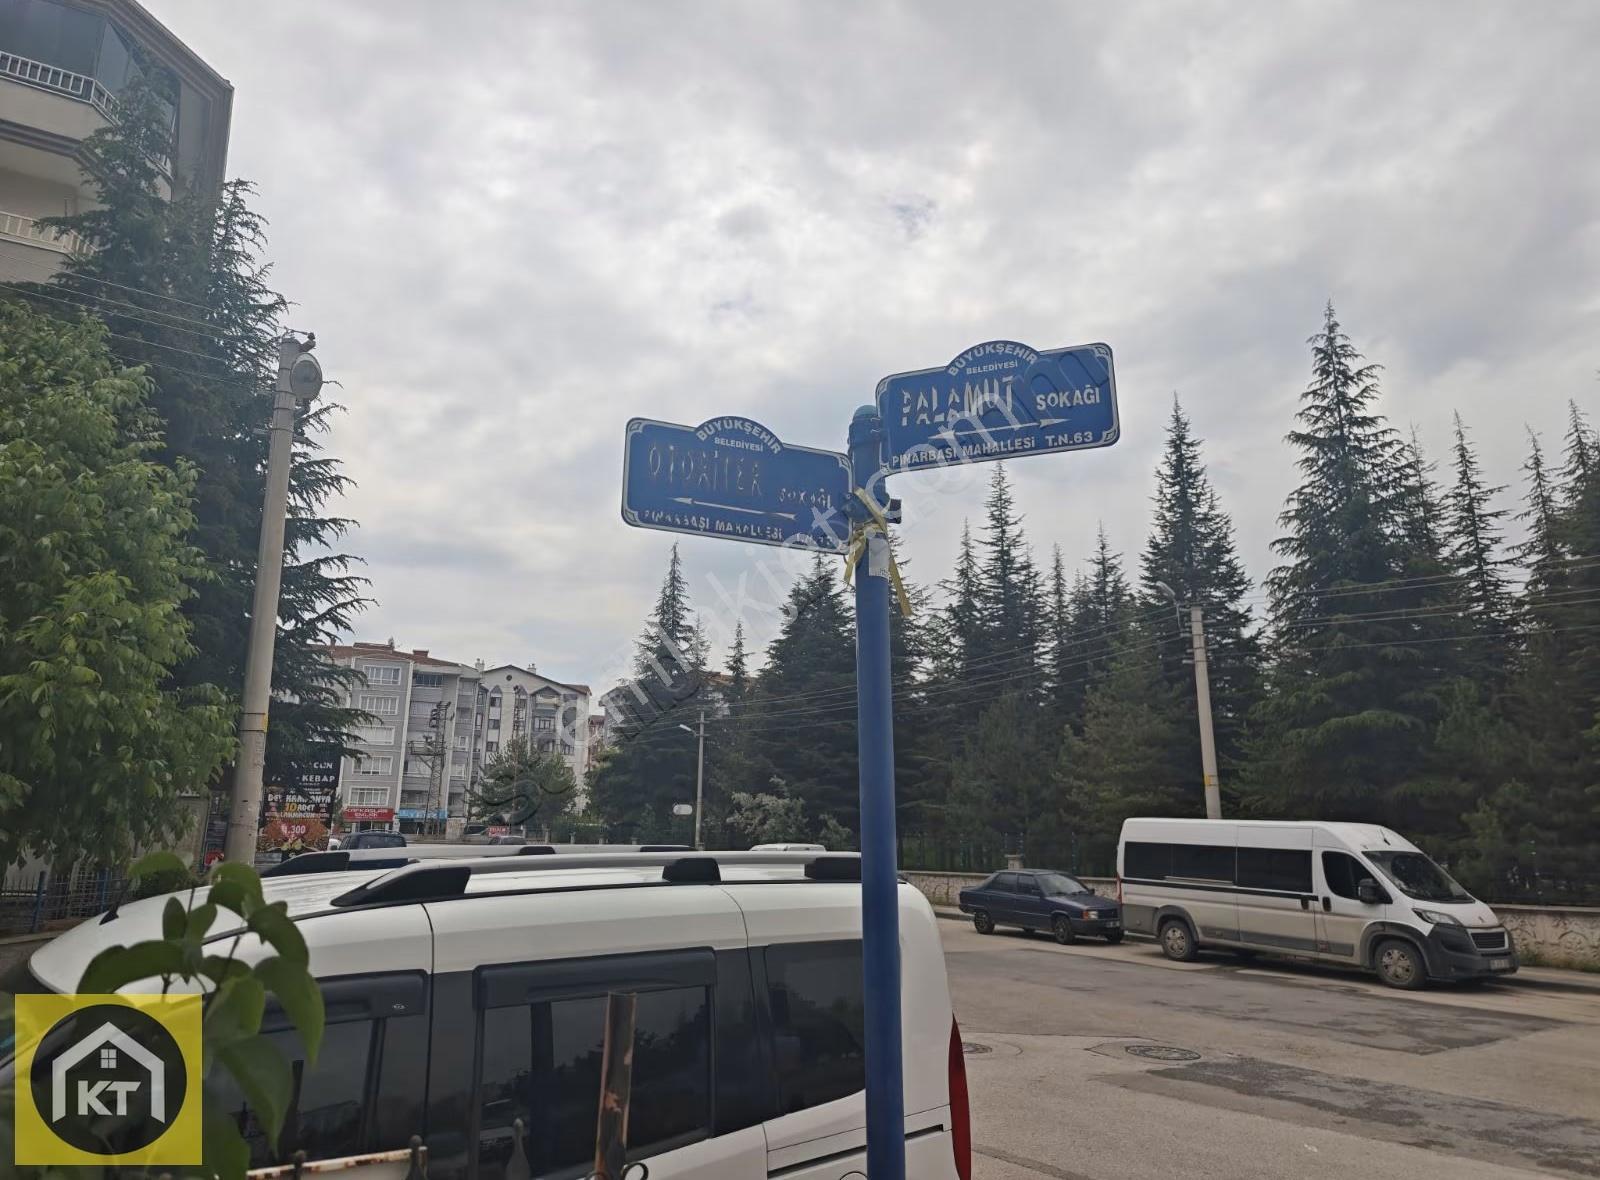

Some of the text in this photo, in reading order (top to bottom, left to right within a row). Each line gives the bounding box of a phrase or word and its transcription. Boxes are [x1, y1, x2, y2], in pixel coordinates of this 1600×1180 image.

[948, 343, 1038, 377] BÜYÜKŞEHİR
[966, 360, 1018, 375] BELEDİYESİ
[901, 375, 1100, 427] PALAMUT SOKAĞI
[696, 417, 783, 455] BÜYÜKŞEHİR
[714, 437, 764, 452] BELEDİYESİ
[962, 436, 1035, 456] MAHALLESİ
[1045, 431, 1093, 447] T.N.63
